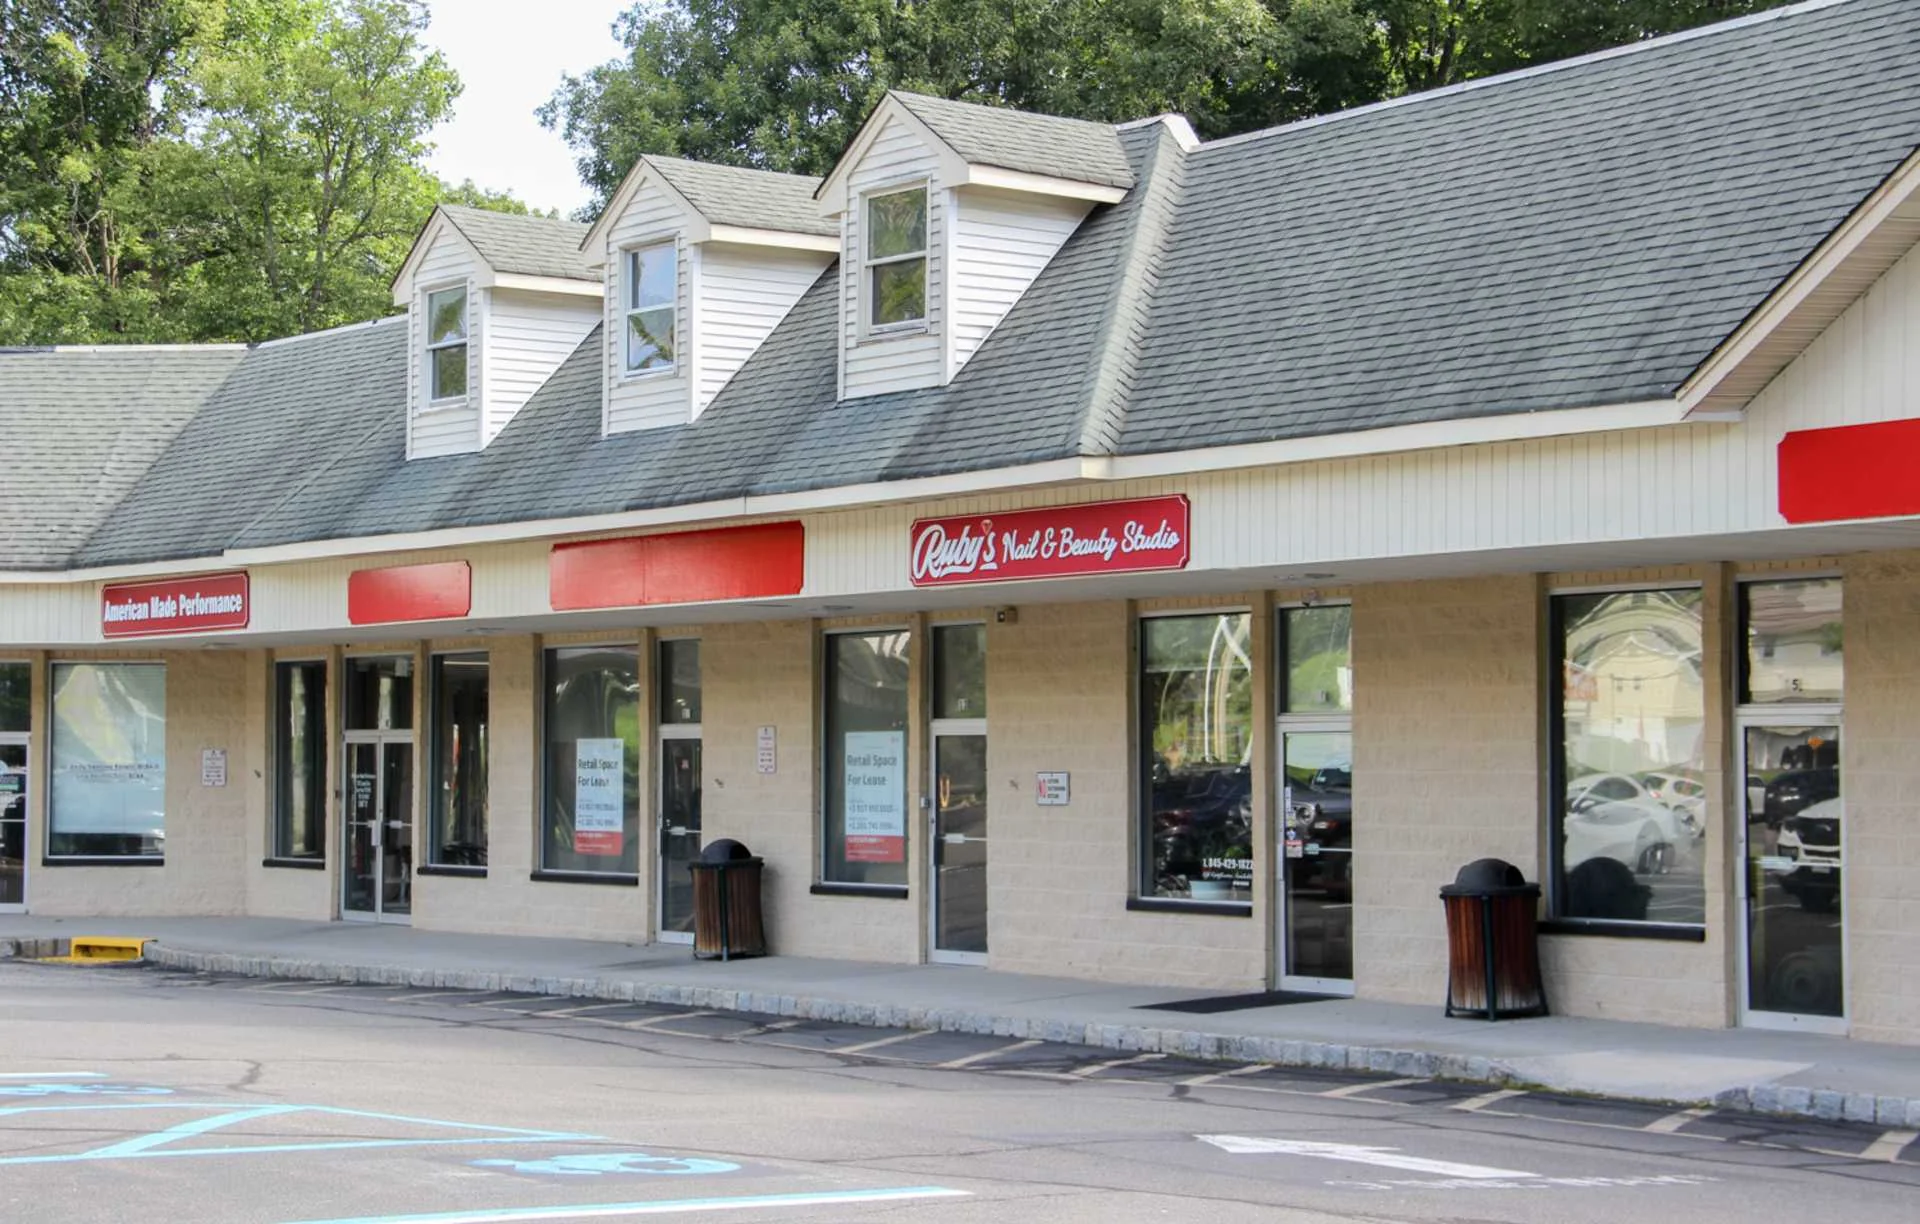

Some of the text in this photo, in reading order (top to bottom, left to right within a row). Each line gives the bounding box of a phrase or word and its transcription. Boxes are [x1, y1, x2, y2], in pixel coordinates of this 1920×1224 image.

[912, 519, 1180, 579] Ruby's Nail & Beauty Studio
[104, 592, 242, 622] American Made Performance
[846, 754, 898, 768] Retail Space
[846, 774, 887, 786] For Lease
